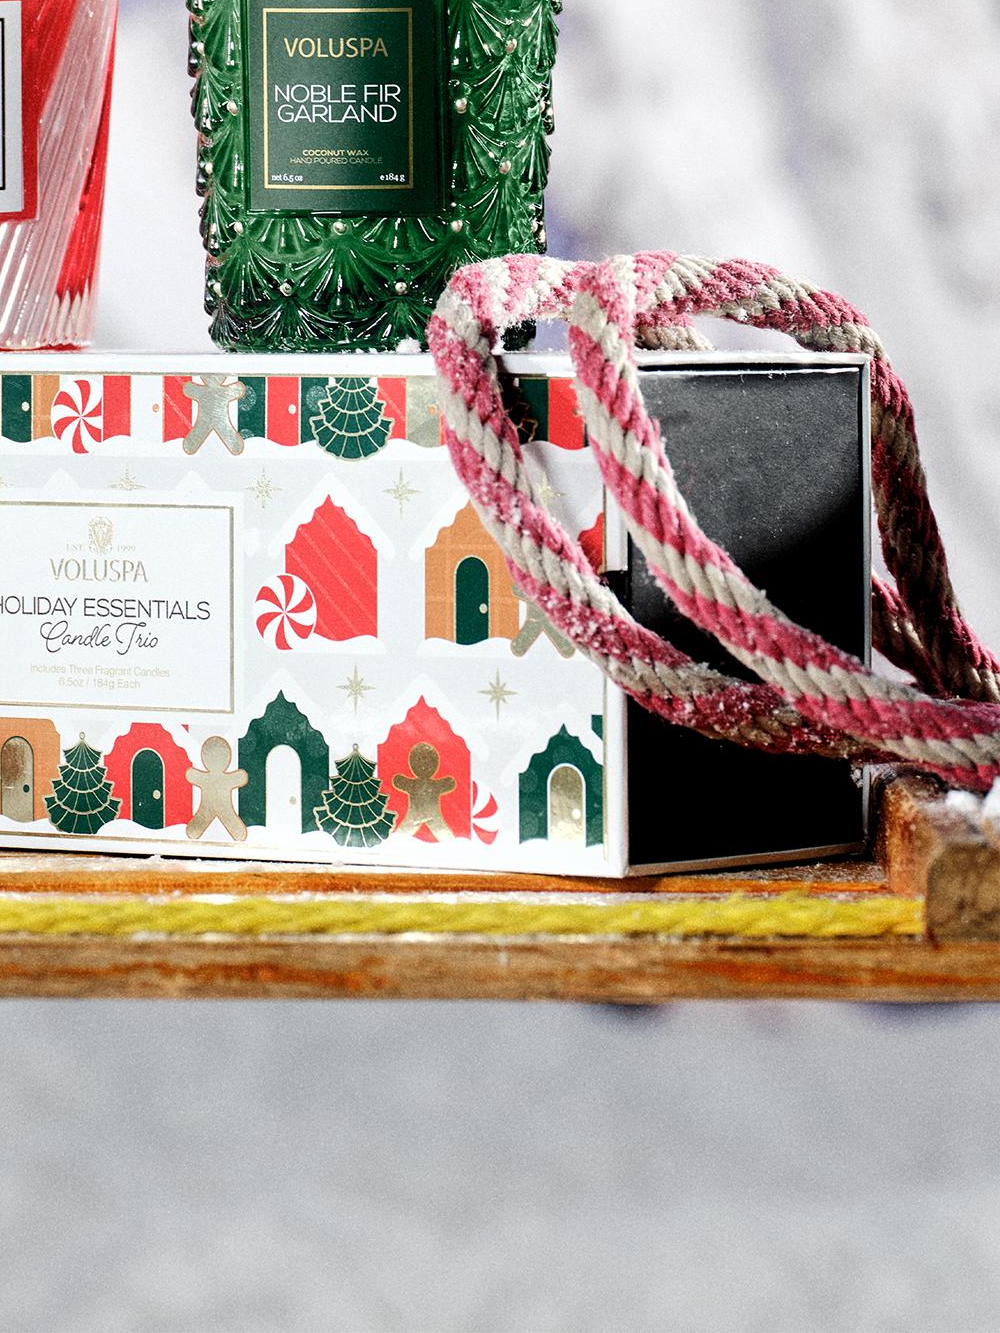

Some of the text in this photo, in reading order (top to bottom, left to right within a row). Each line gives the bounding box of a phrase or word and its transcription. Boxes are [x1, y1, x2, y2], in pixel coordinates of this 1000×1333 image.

[283, 37, 389, 59] VOLUSPA
[274, 83, 401, 103] NOBLE FIR
[277, 104, 397, 123] GARLAND
[302, 149, 370, 157] COCONUT WAX
[313, 157, 348, 165] POURED
[349, 156, 384, 164] CANDLE
[50, 557, 149, 583] VOLUSPA
[83, 597, 211, 621] ESSENTIALS
[39, 620, 159, 656] Candle Trio
[30, 662, 170, 678] Includes Three Fragrant Candles
[117, 678, 141, 690] Each
